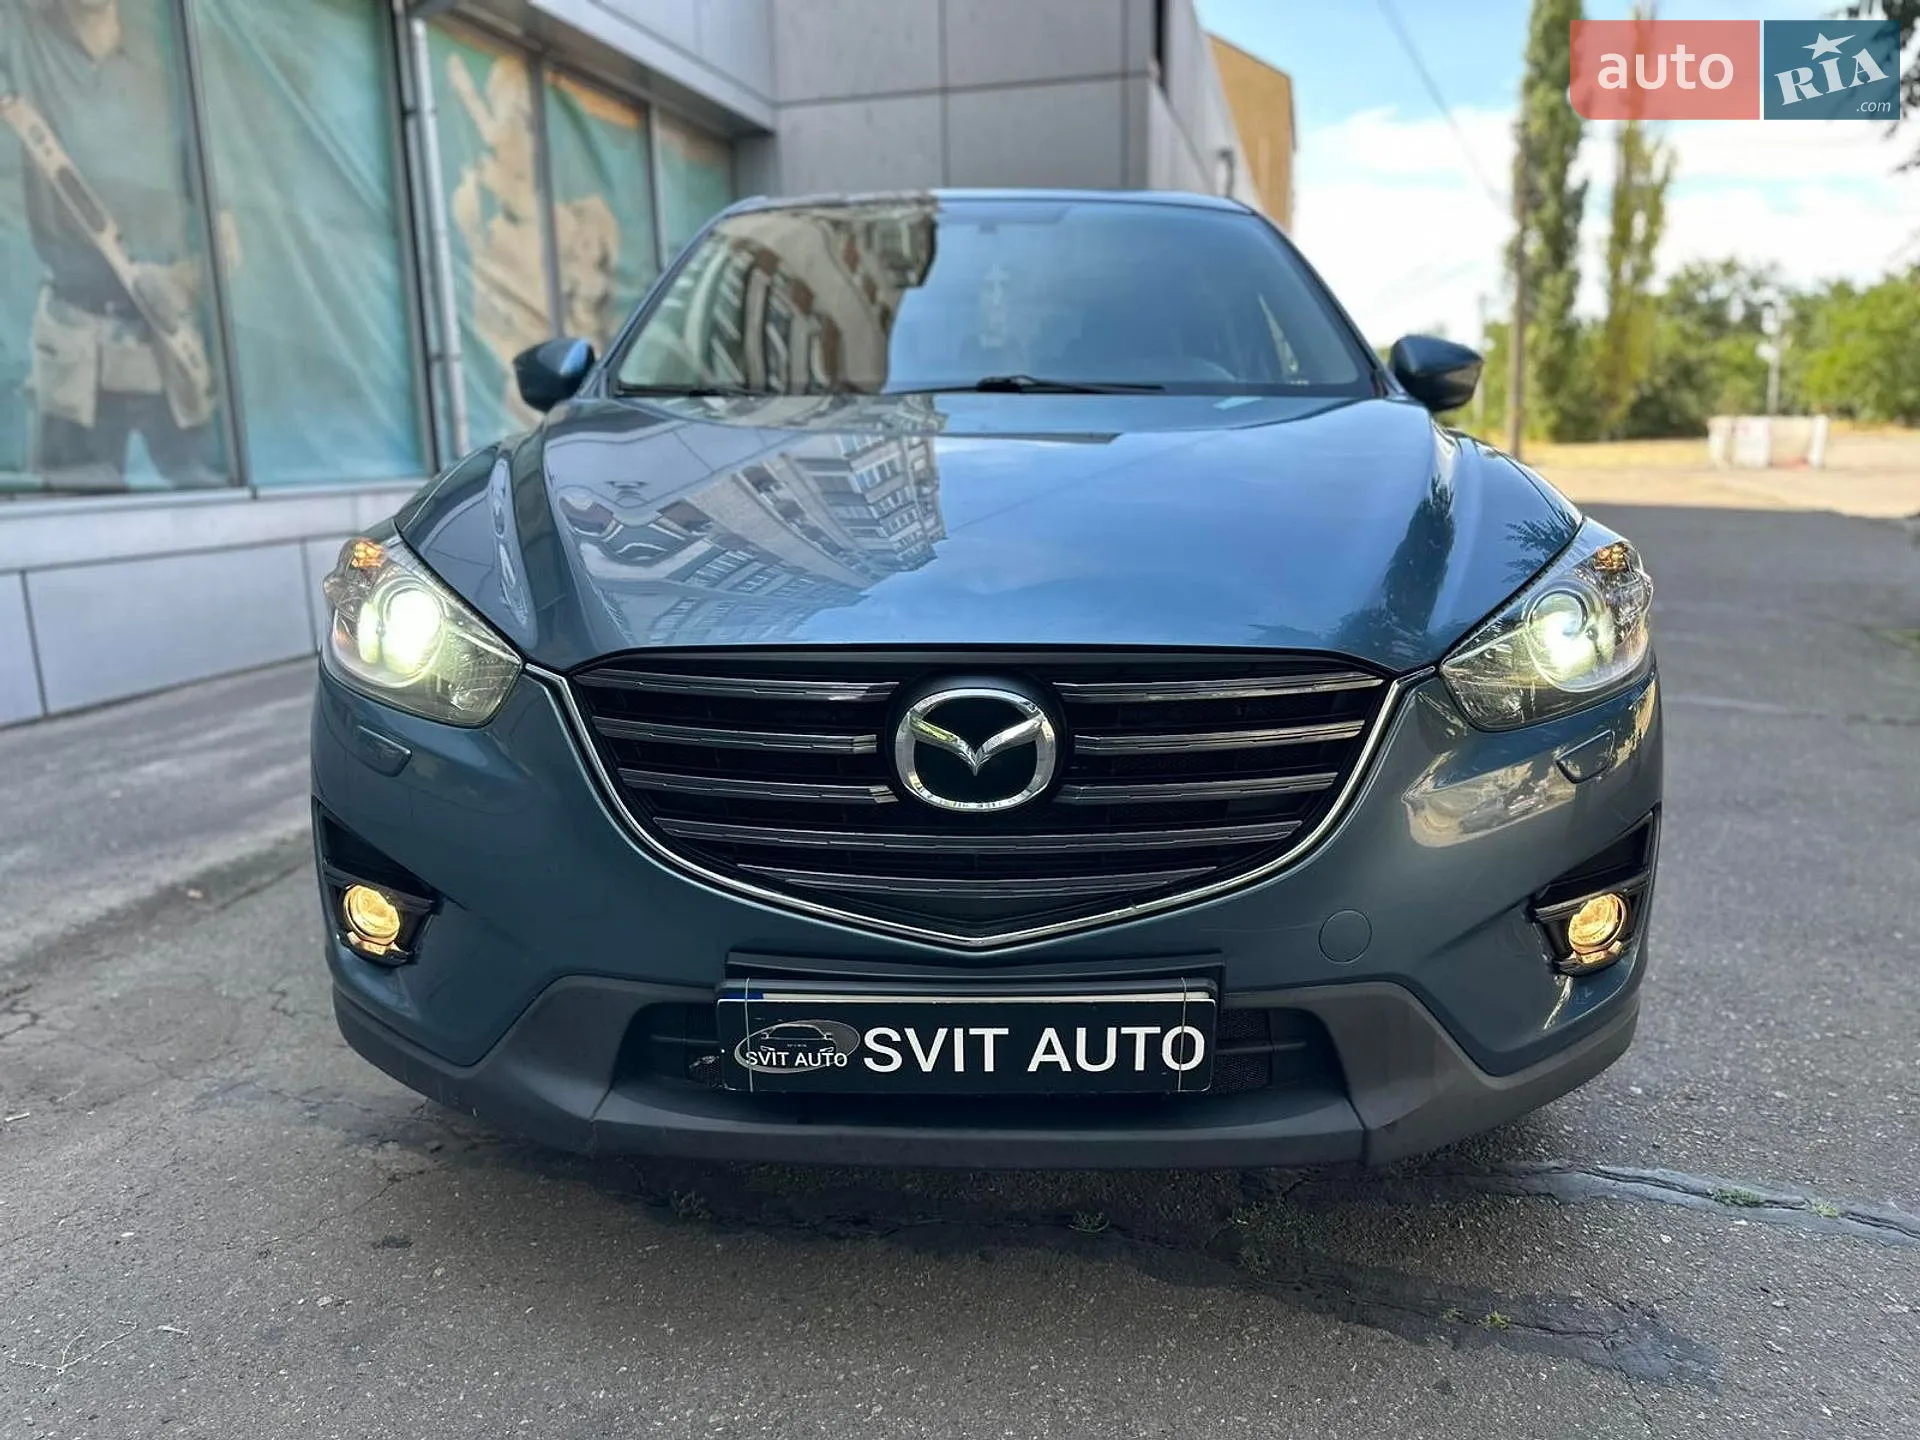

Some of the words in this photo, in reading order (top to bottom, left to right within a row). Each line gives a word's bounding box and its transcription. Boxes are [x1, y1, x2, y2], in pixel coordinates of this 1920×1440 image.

[745, 1051, 789, 1068] SVIT
[794, 1051, 848, 1068] AUTO
[862, 1026, 1009, 1073] SVIT
[1027, 1026, 1206, 1073] AUTO
